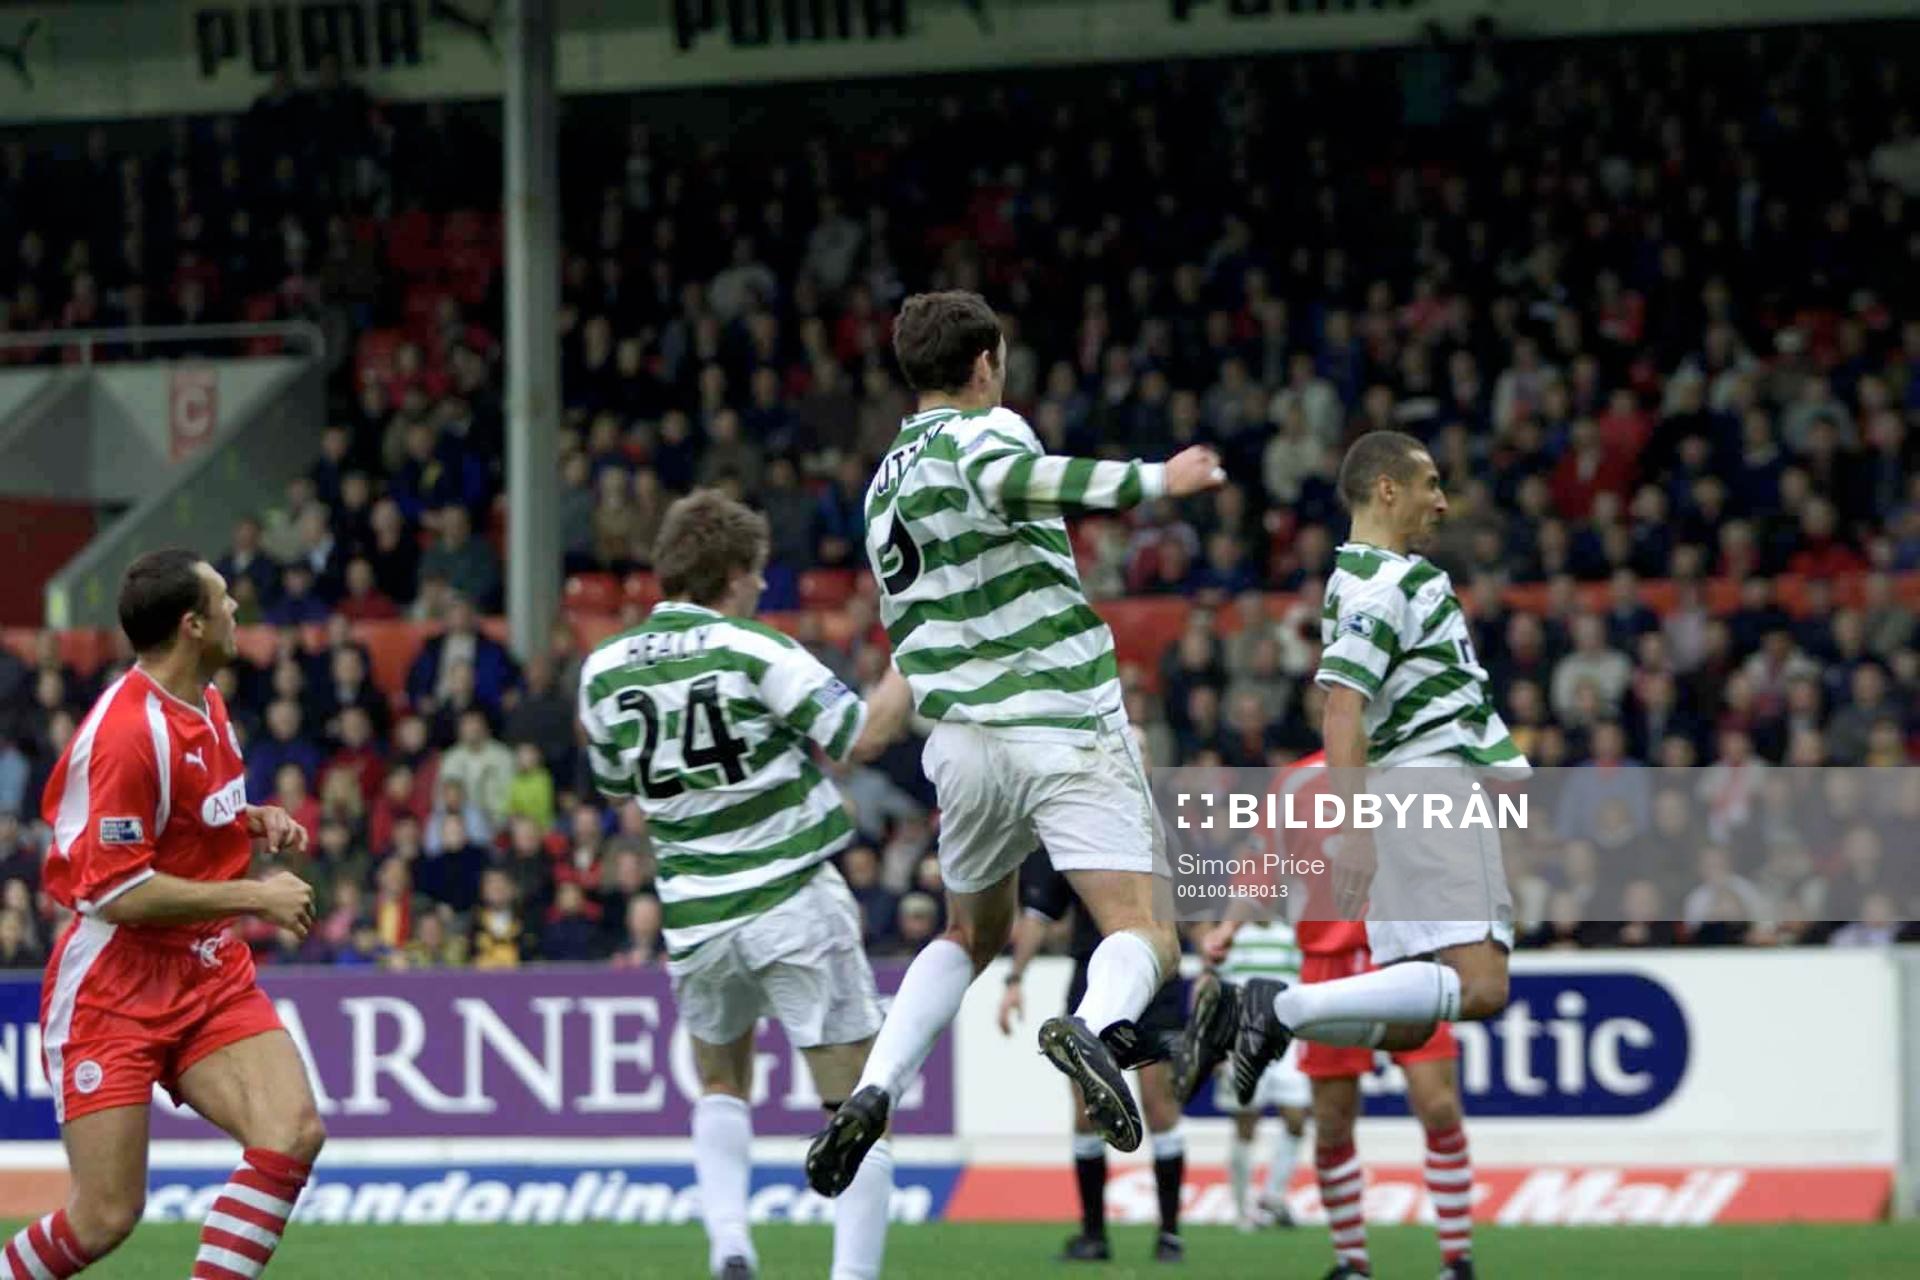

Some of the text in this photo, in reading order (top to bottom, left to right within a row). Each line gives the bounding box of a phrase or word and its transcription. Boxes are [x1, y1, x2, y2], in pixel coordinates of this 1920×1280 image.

[194, 4, 421, 79] PUMA
[616, 674, 748, 799] 24
[1494, 1166, 1746, 1229] Mail
